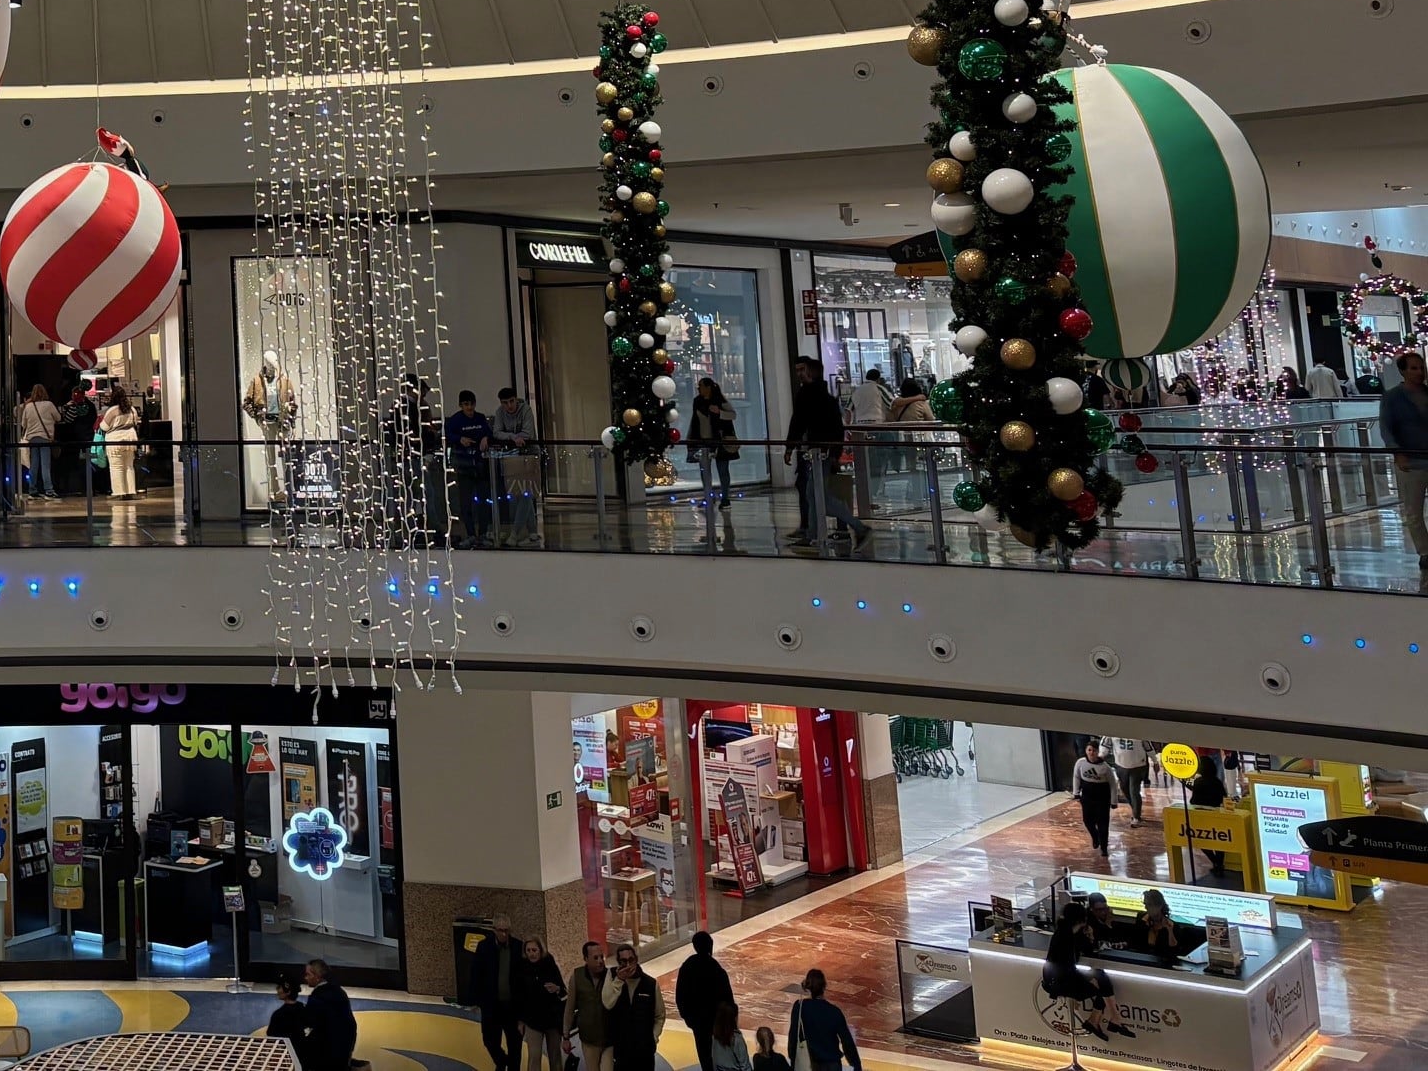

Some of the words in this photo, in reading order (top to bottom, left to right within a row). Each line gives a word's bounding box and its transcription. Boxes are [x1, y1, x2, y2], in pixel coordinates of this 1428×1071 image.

[529, 243, 594, 264] CORTEFIEL
[60, 683, 186, 713] yoigo
[1165, 756, 1195, 766] Jazztel
[1271, 788, 1310, 800] Jazztel
[1178, 823, 1232, 842] Jazztel
[1363, 837, 1393, 849] Planta
[994, 1029, 1007, 1037] Oro
[1010, 1032, 1028, 1041] Plata
[1031, 1035, 1056, 1046] Relojes
[1066, 1042, 1088, 1051] Mrca
[1091, 1046, 1119, 1057] Piedras
[1119, 1050, 1153, 1063] Preciosas
[1156, 1057, 1187, 1069] Lingotes
[1187, 1063, 1198, 1071] de
